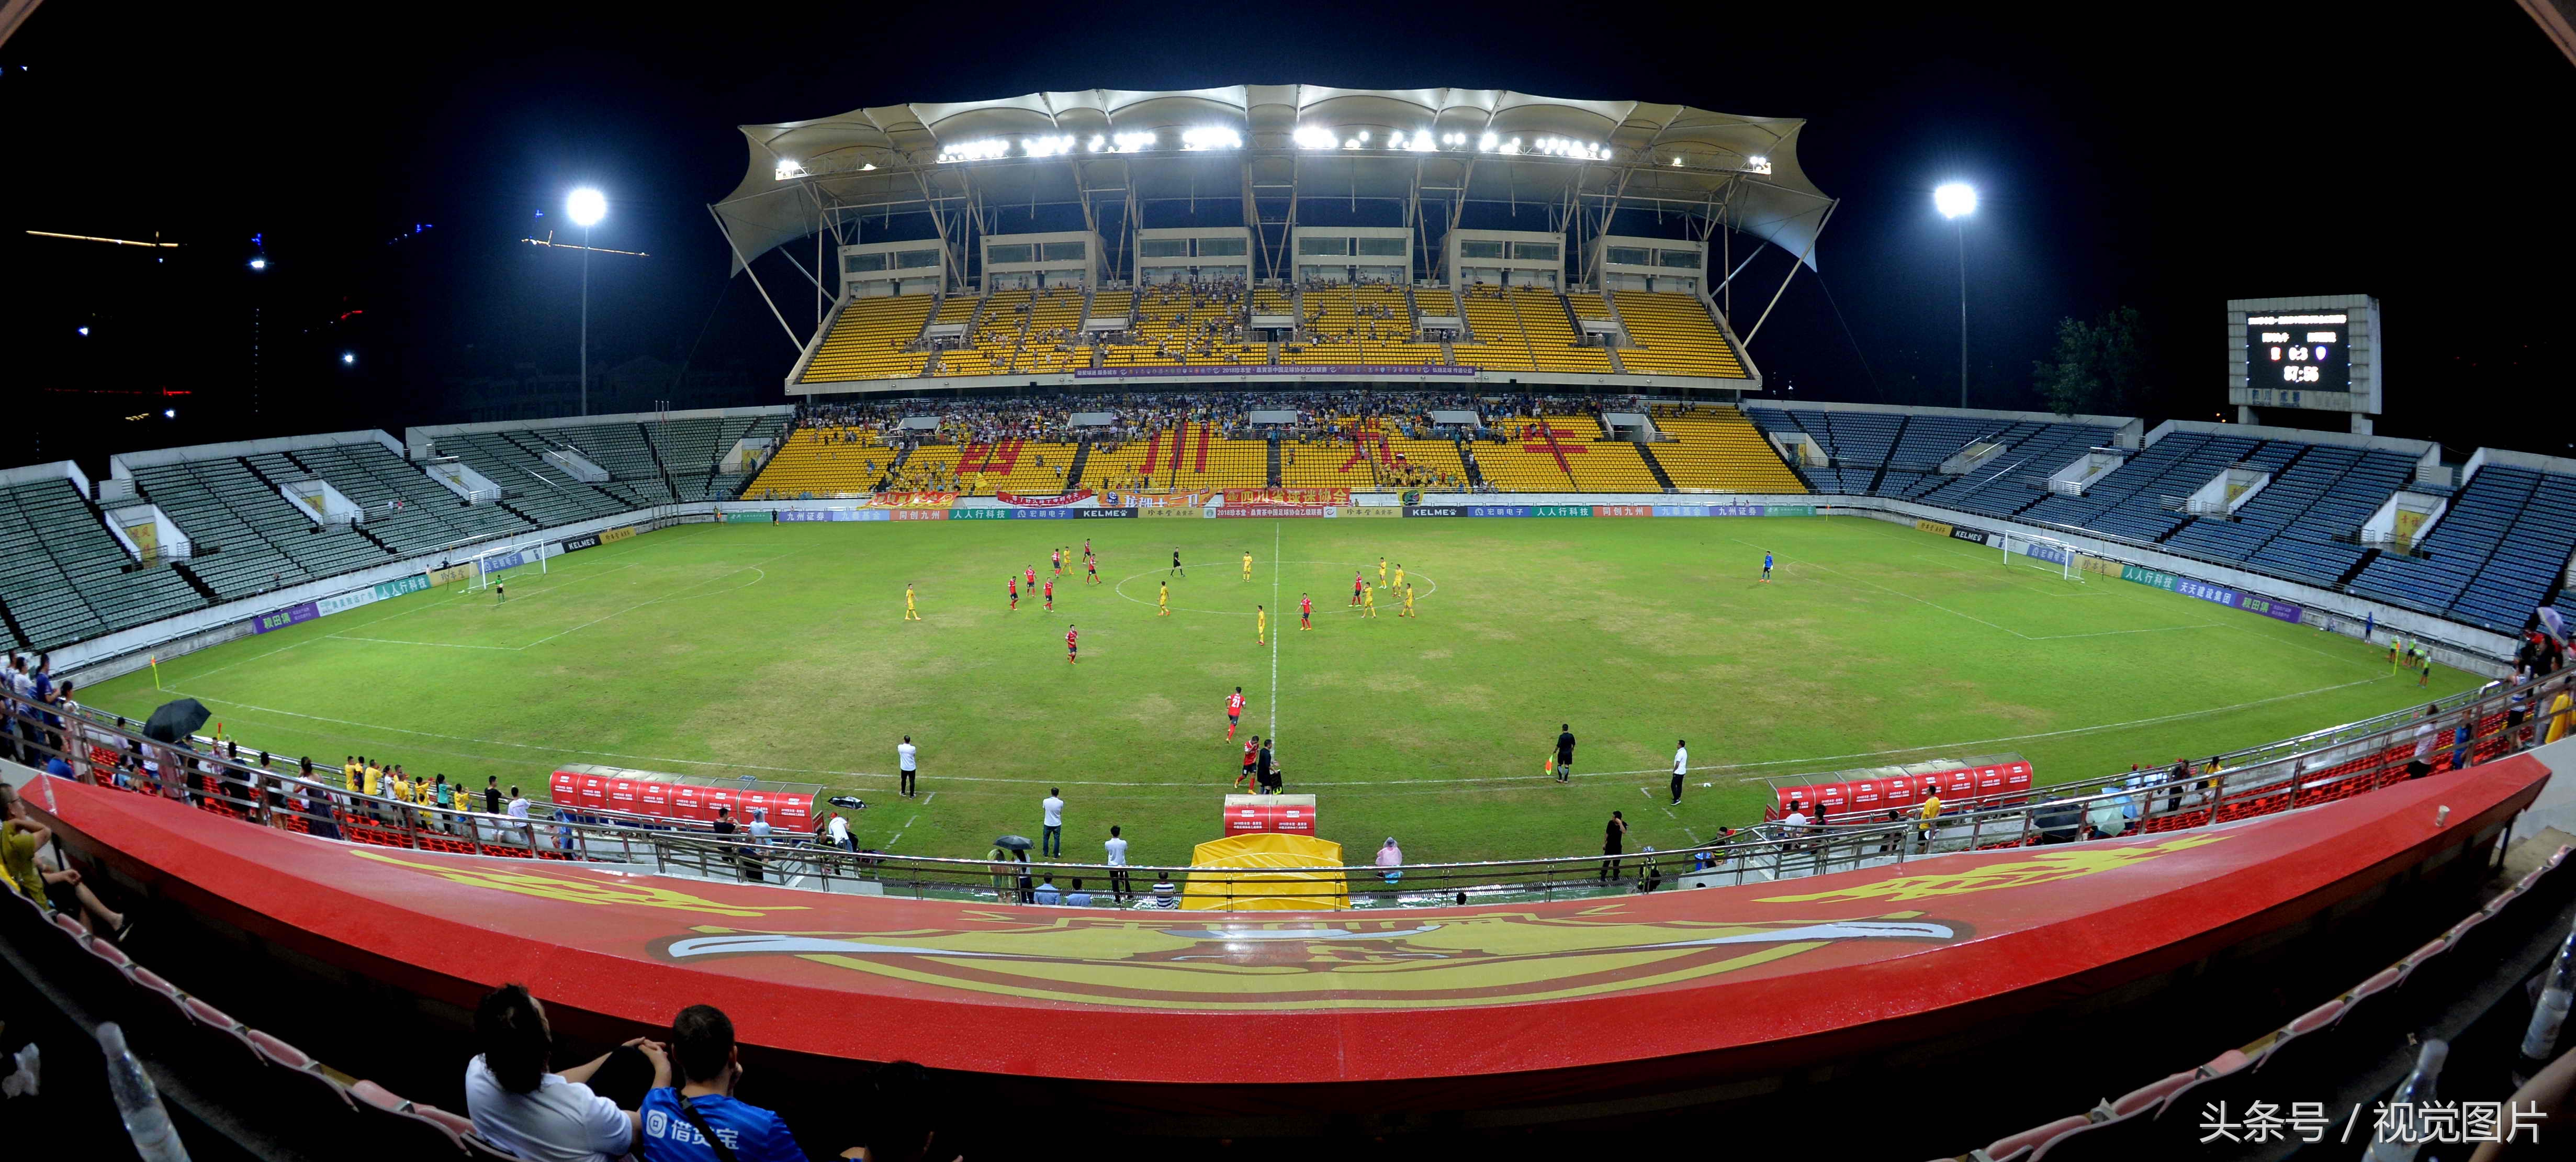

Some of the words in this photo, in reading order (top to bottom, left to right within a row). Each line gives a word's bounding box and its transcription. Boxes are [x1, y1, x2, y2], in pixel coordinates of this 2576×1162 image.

[1241, 488, 1347, 505] 四川省球迷协会
[787, 512, 825, 521] 九州证券
[899, 511, 940, 520] 同创九州
[954, 510, 1005, 519] 人人行科技
[1537, 507, 1589, 516] 人人行科技
[1603, 507, 1644, 516] 同创九州
[1719, 507, 1757, 516] 九州证券
[1955, 530, 1978, 541] KELME
[568, 539, 591, 550] KELME
[2126, 568, 2173, 588] 人人行科技
[381, 576, 428, 597] 人人行科技
[2180, 582, 2232, 605] 天天建设集团
[1231, 698, 1240, 708] 21
